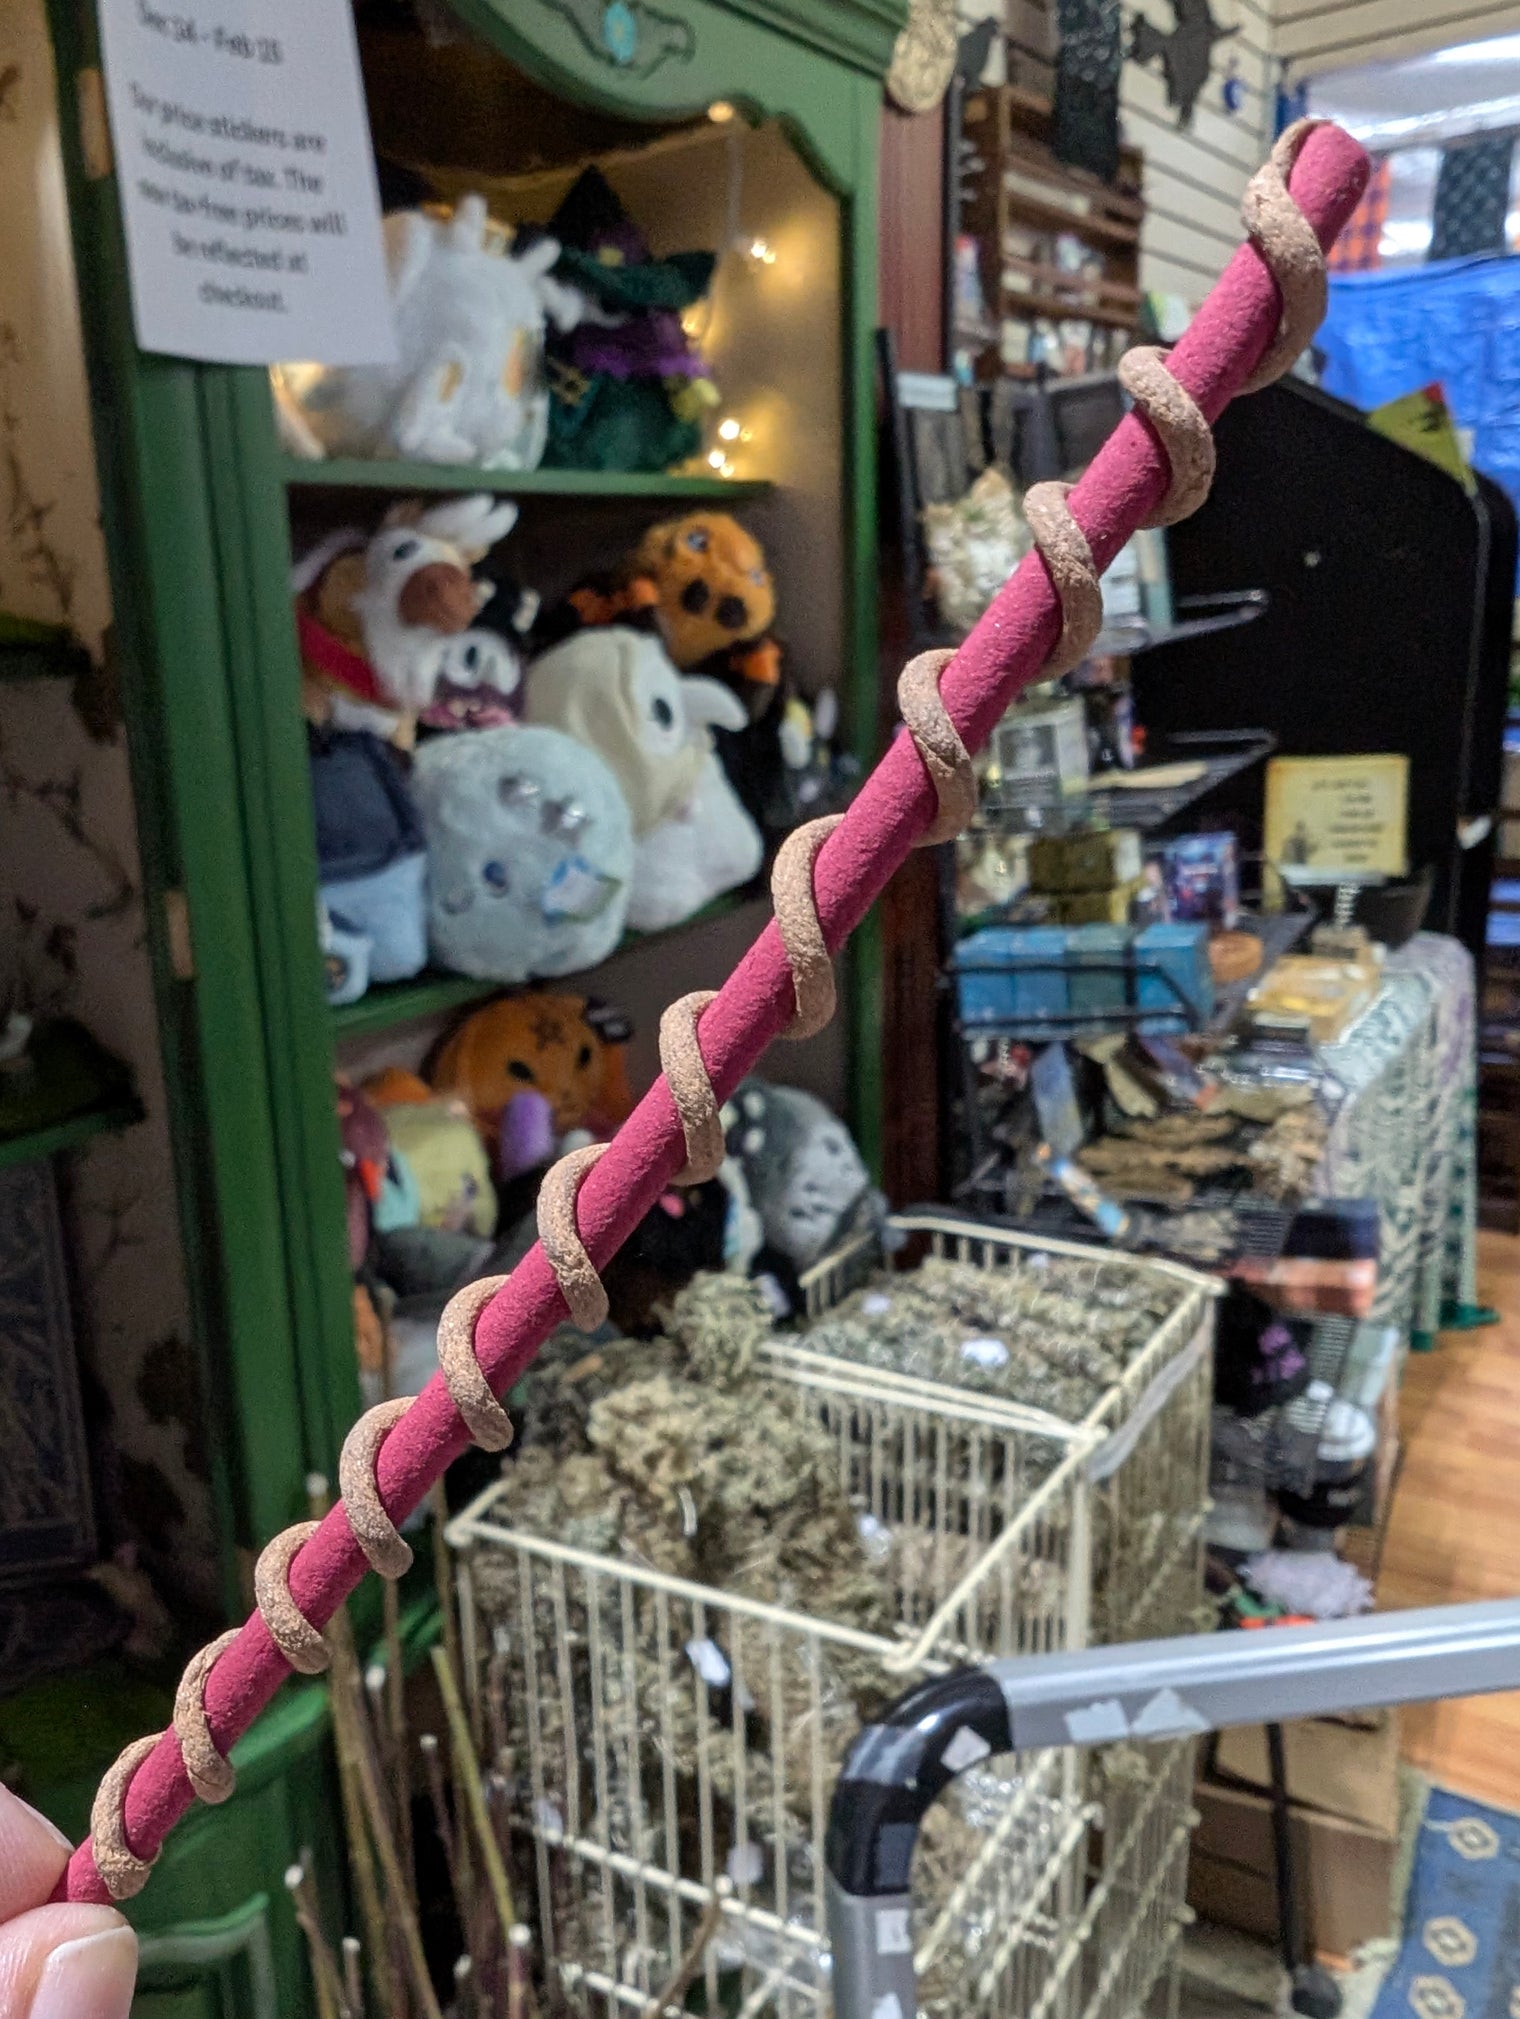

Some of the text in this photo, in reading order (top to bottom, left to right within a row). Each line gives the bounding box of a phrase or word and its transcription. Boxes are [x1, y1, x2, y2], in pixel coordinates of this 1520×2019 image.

[207, 117, 286, 148] stickers
[294, 133, 326, 153] are
[219, 158, 240, 181] of
[284, 166, 322, 194] The
[243, 207, 304, 232] prices
[310, 212, 347, 236] will
